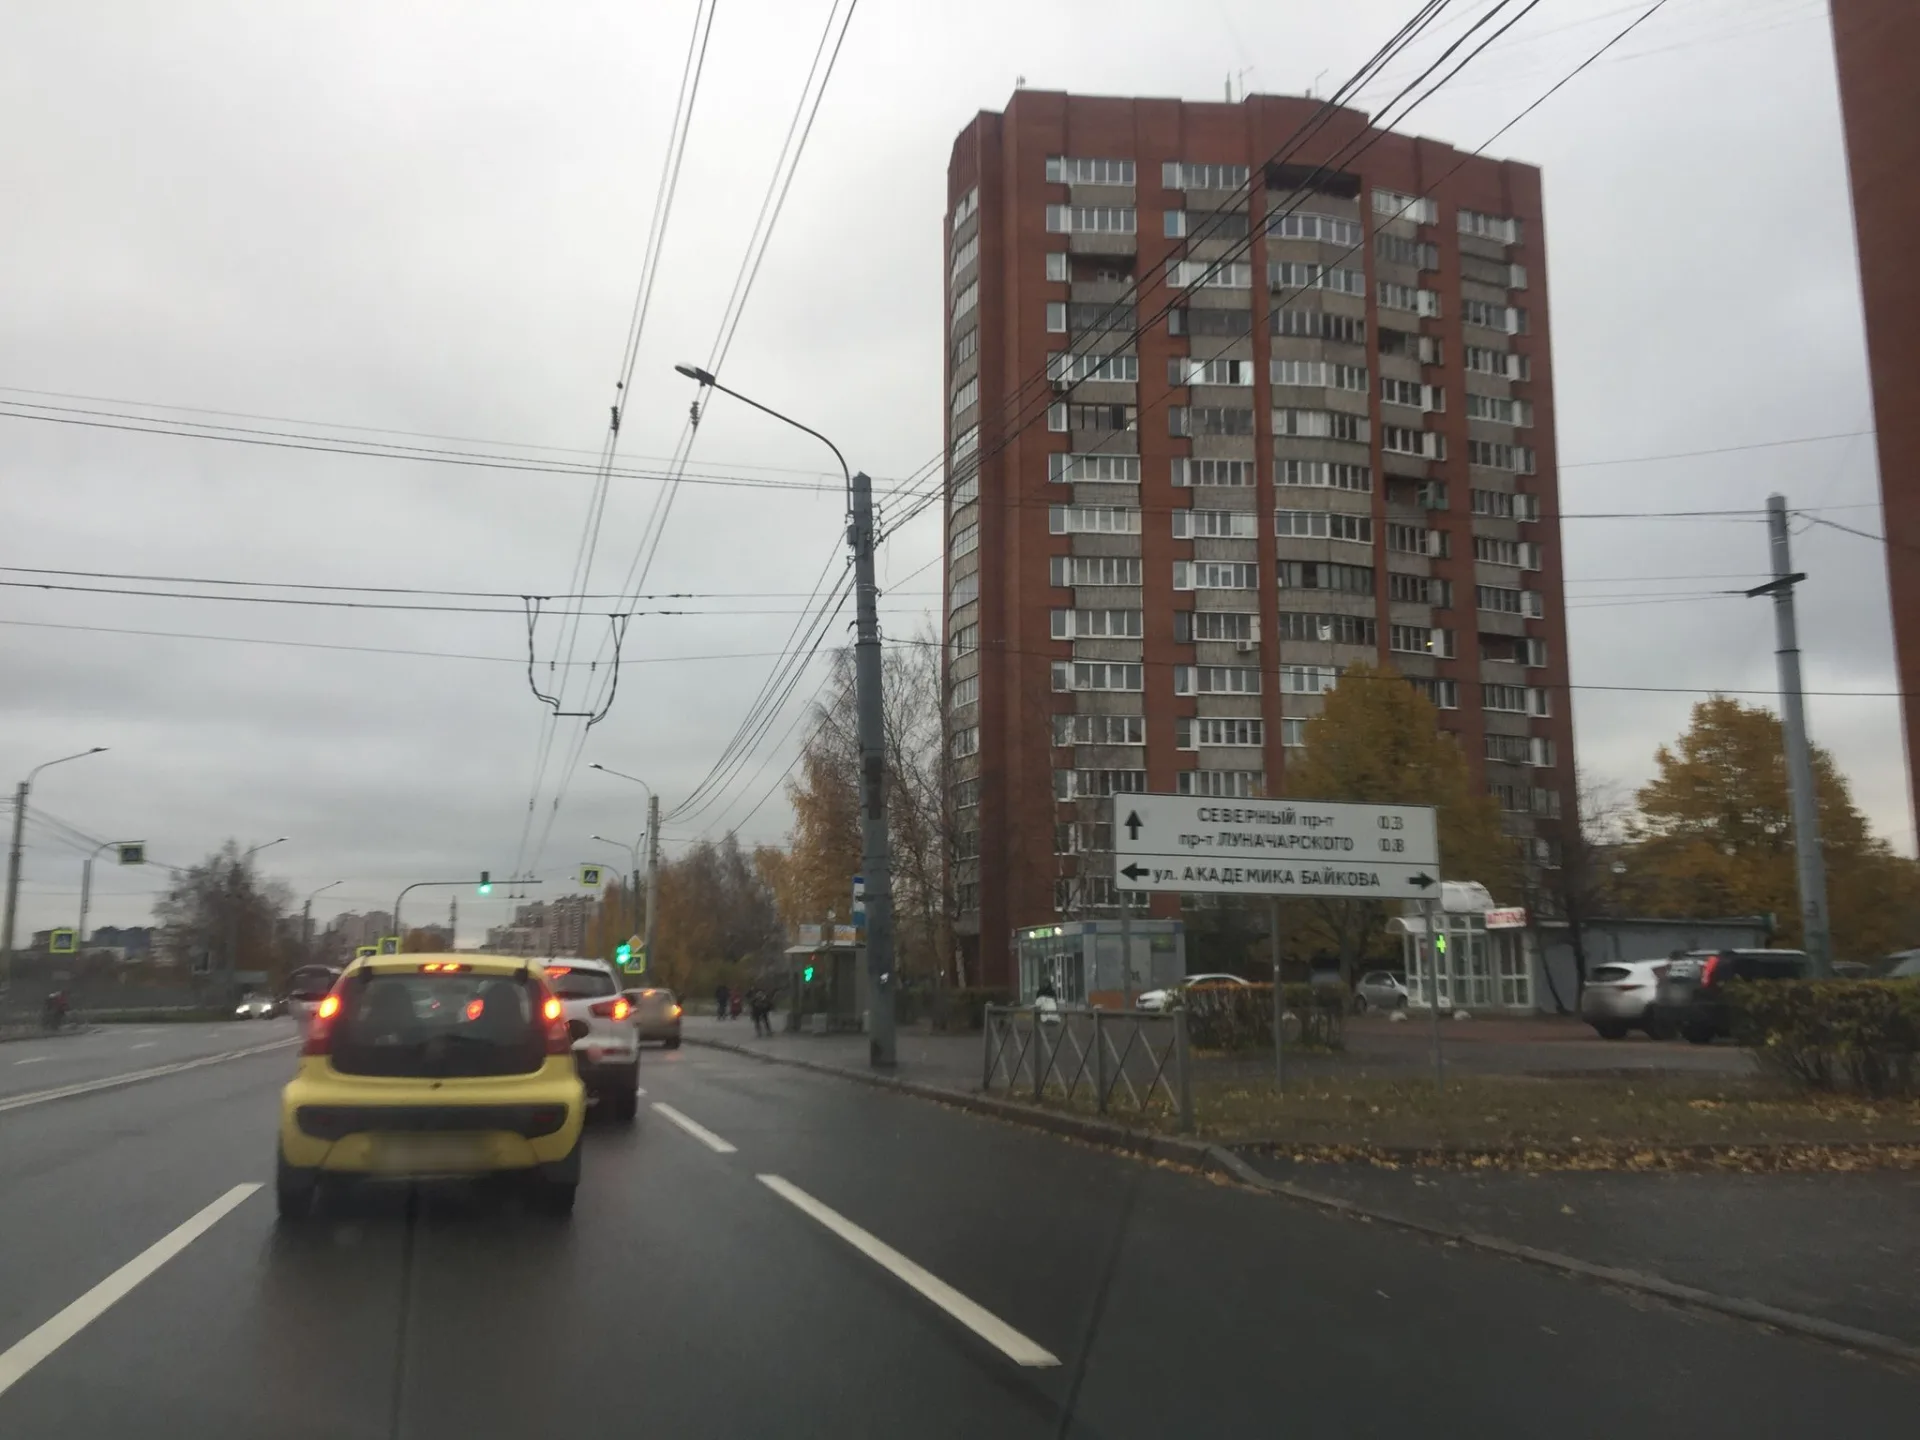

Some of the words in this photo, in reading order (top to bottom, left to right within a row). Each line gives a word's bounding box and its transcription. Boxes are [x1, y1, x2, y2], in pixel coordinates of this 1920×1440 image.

[1197, 807, 1297, 826] СЕВЕРНЫЙ
[1301, 814, 1335, 829] пр-т
[1179, 834, 1213, 849] пр-т
[1217, 833, 1354, 851] ЛУНАЧАРСКОГО
[1152, 869, 1178, 884] ул.
[1184, 866, 1295, 885] АКАДЕМИКА
[1301, 867, 1380, 887] БАЙКОВА
